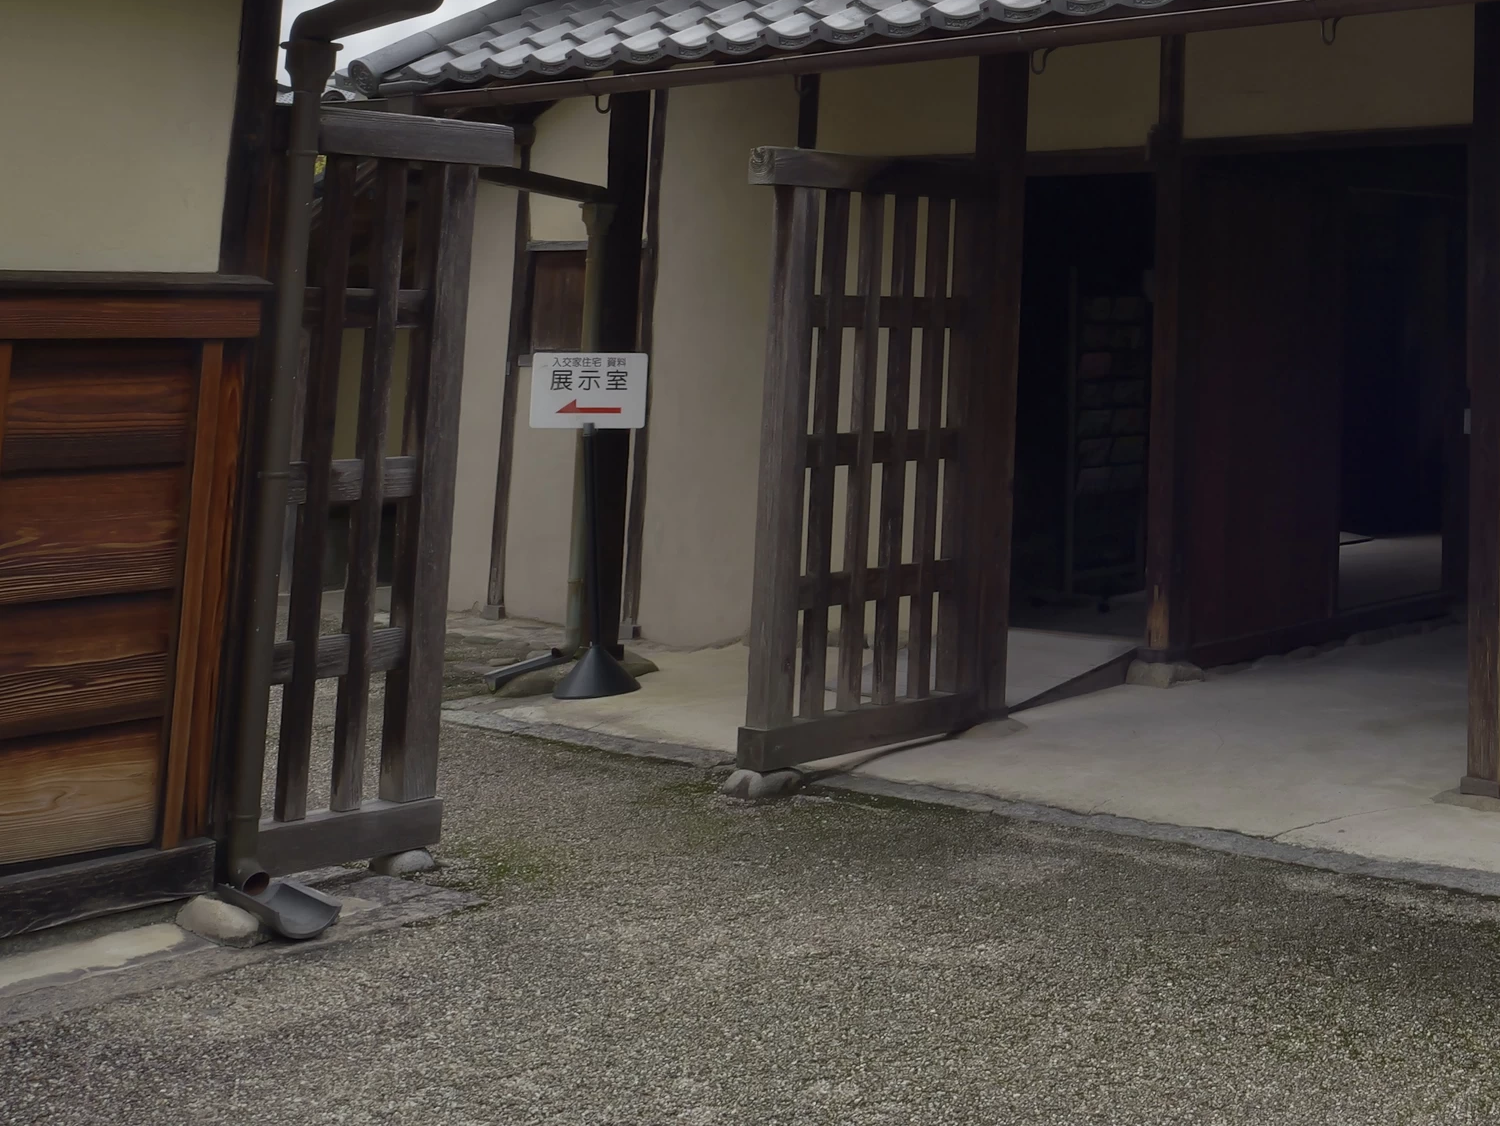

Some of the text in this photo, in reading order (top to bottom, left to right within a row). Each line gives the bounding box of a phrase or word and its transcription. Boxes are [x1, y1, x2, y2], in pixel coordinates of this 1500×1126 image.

[552, 357, 626, 368] 入交家住宅 資料
[550, 369, 628, 391] 展示室
